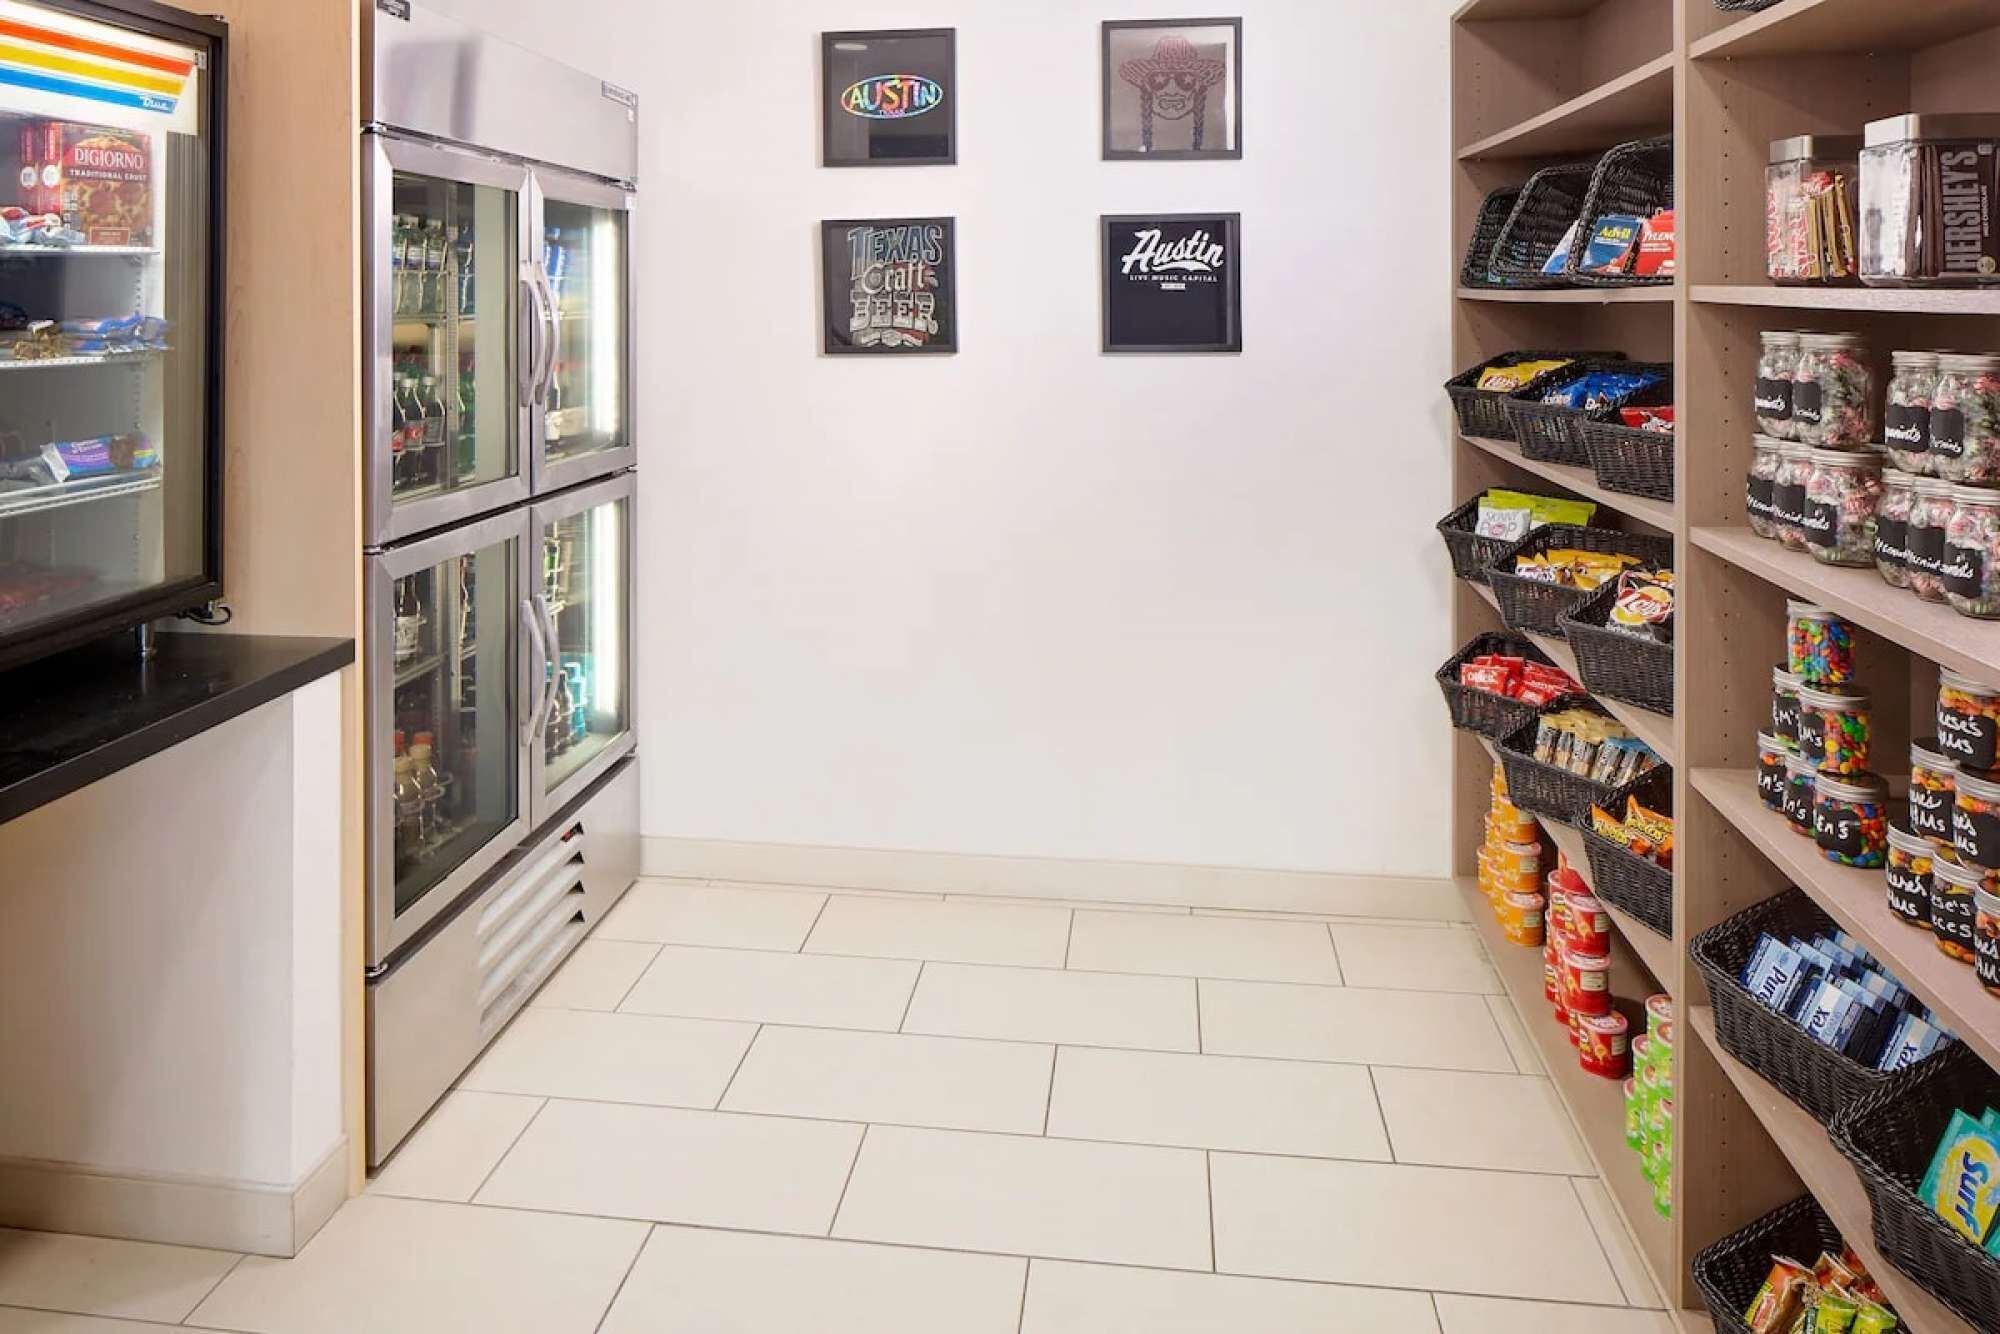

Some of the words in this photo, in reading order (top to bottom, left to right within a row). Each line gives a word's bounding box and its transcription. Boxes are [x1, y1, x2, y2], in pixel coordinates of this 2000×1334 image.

[849, 79, 936, 111] AUSTIN
[1940, 151, 1981, 271] HERSHEY'S
[848, 225, 943, 281] TEXAS
[1120, 228, 1225, 275] Austin
[861, 260, 926, 295] Craft
[849, 291, 940, 335] BEER
[1955, 1151, 1990, 1238] Surf
